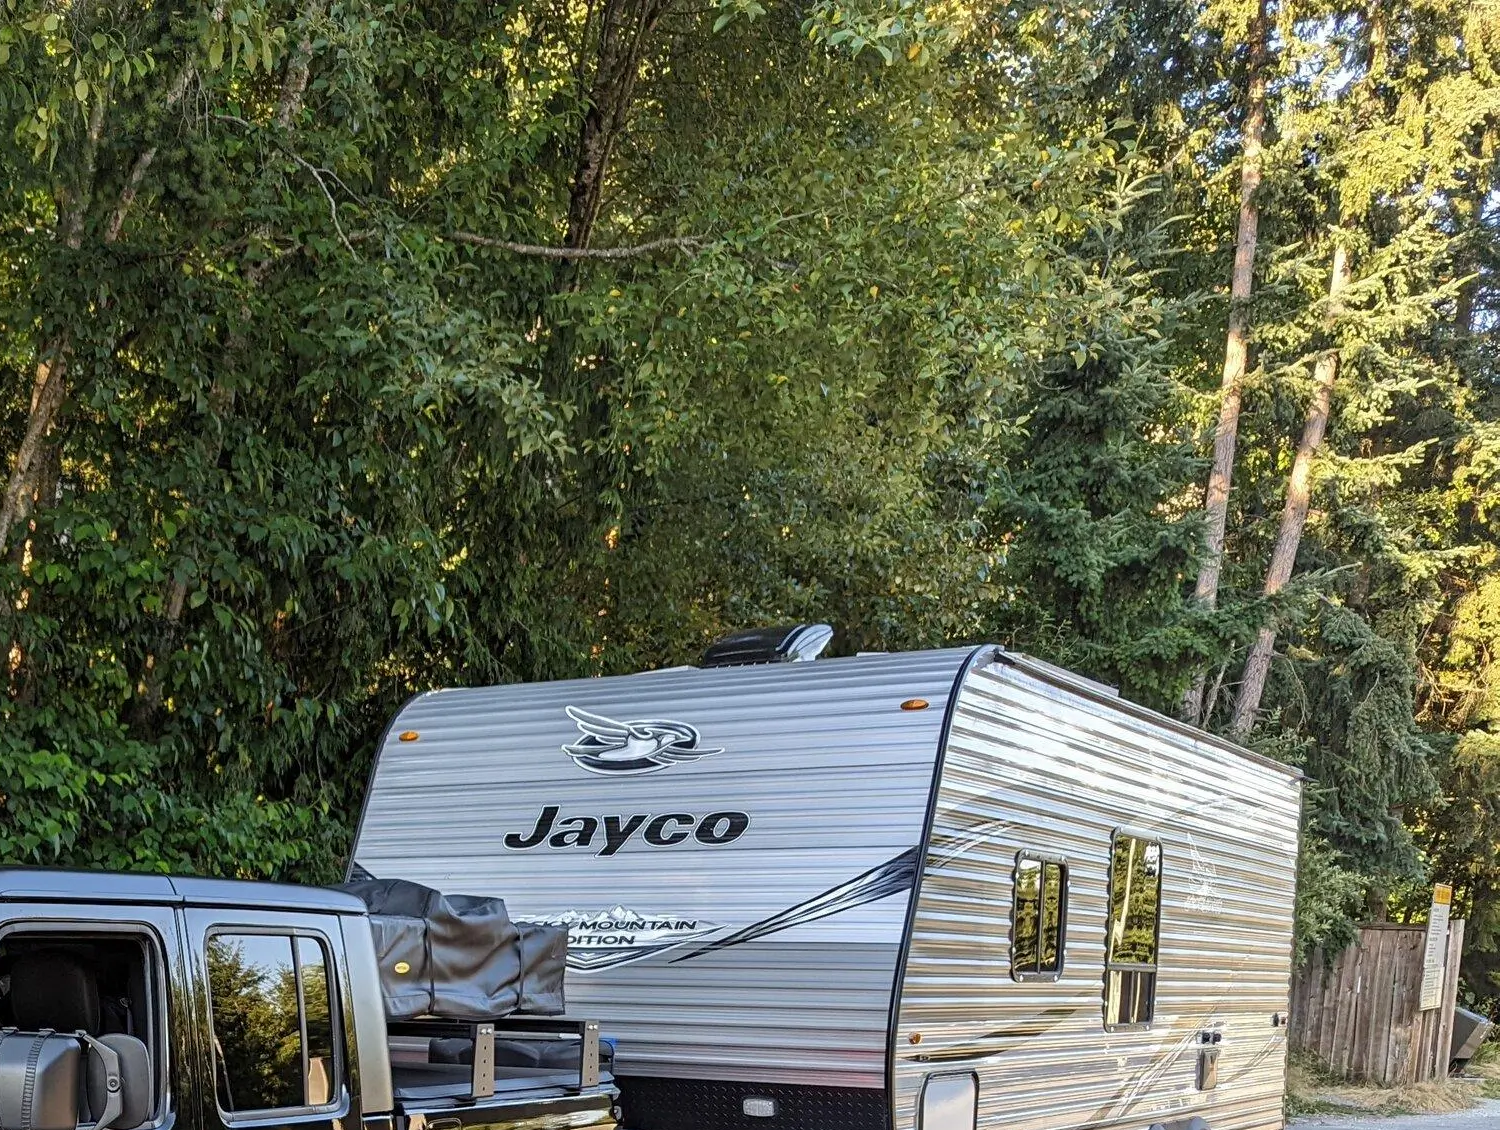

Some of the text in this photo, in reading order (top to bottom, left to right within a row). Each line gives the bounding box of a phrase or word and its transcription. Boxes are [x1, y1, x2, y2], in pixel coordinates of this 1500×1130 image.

[502, 804, 750, 858] Jayco
[578, 920, 698, 931] MOUNTAIN
[567, 935, 636, 945] DITION
